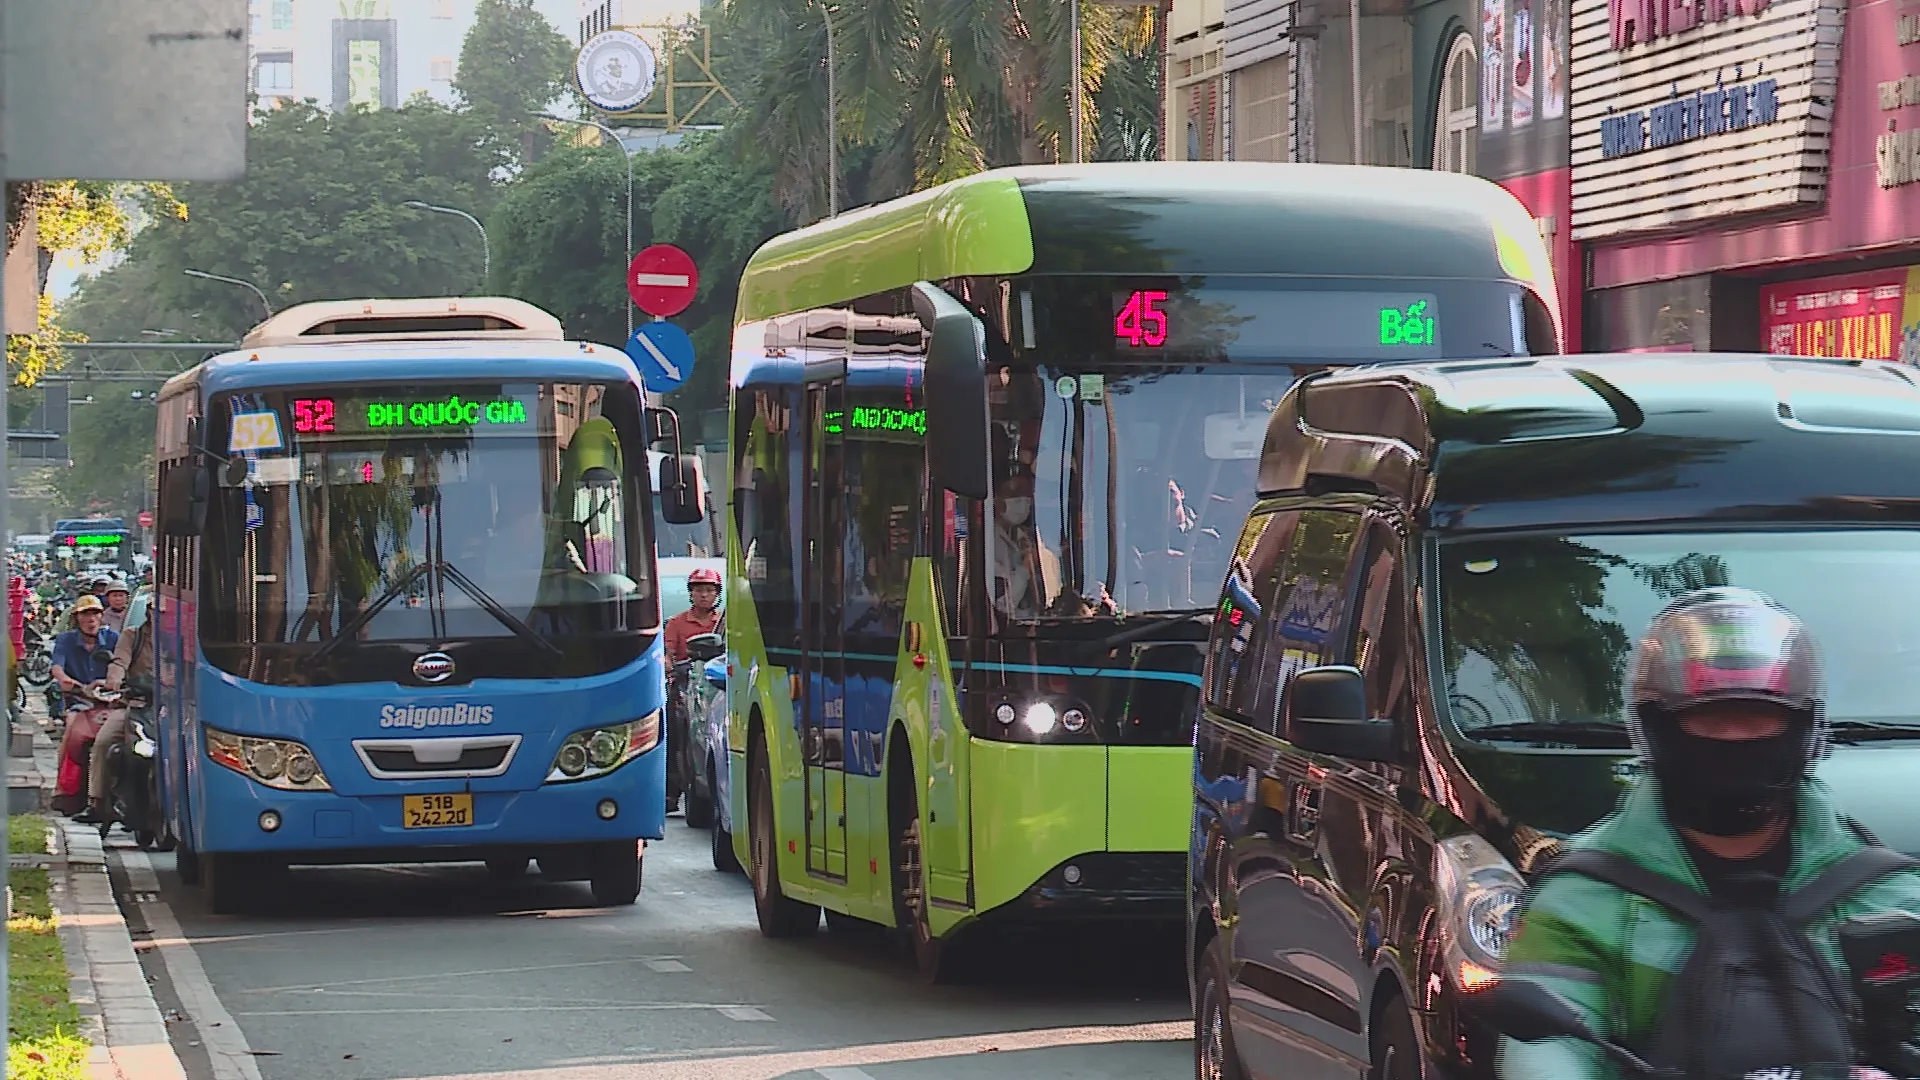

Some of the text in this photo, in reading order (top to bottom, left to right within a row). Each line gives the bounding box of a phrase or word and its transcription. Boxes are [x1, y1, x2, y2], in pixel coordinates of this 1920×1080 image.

[1116, 291, 1167, 345] 45
[1842, 305, 1892, 358] XUÂN
[294, 396, 528, 432] 52 ĐH QUỐC GIA
[236, 415, 277, 448] 52
[380, 703, 494, 730] SaigonBus
[411, 809, 467, 826] 242.20
[423, 796, 454, 810] 51B
